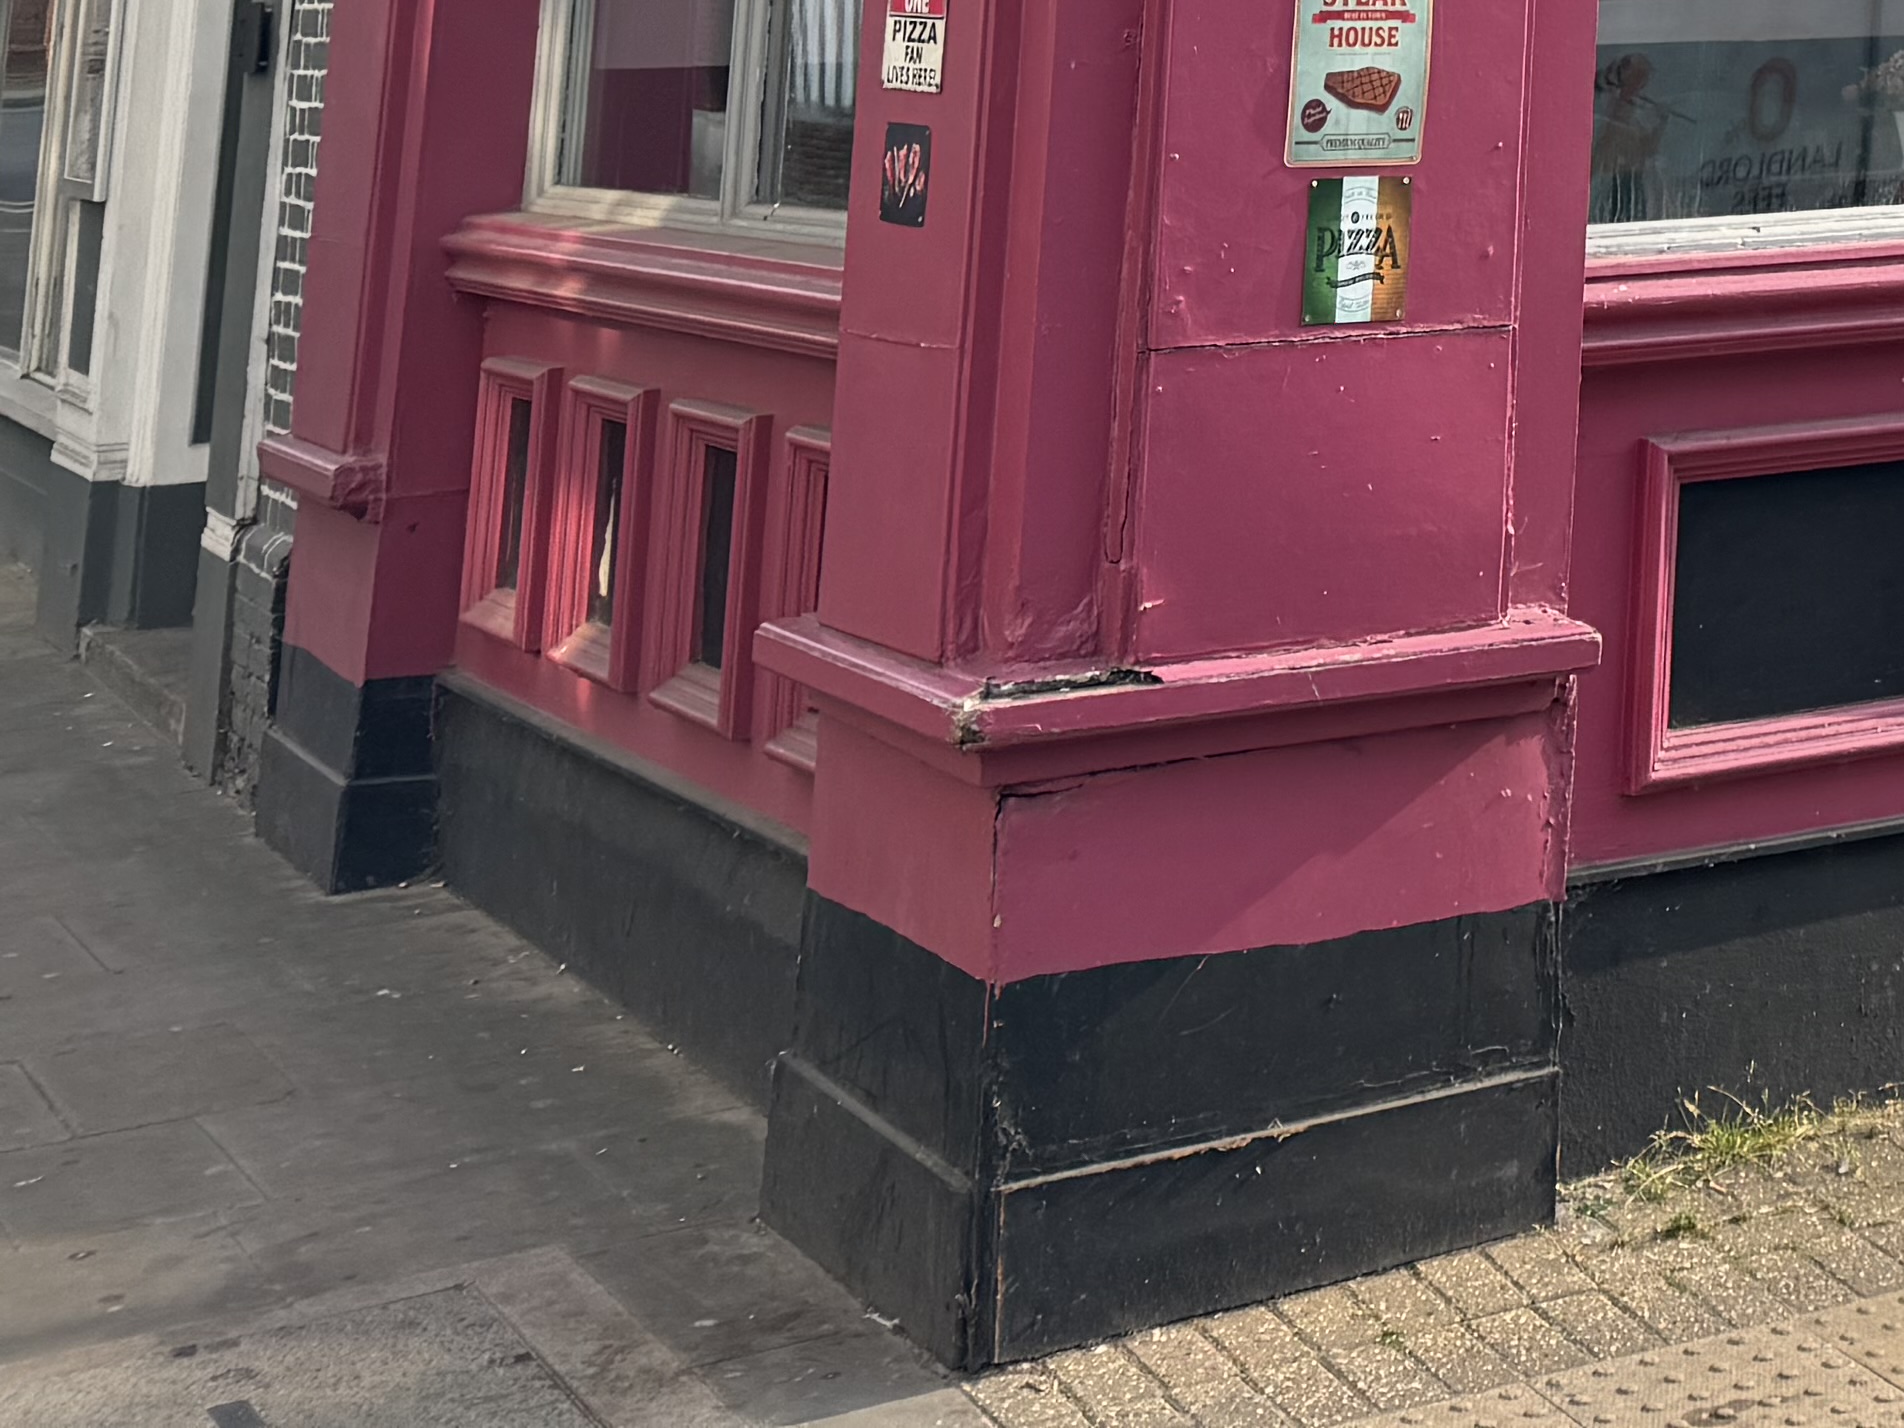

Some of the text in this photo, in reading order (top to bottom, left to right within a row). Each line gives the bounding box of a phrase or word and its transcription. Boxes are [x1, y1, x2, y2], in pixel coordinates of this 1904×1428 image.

[892, 19, 938, 45] PIZZA
[1327, 25, 1400, 48] HOUSE
[904, 45, 924, 65] FAN
[1314, 224, 1402, 273] PIZZA
